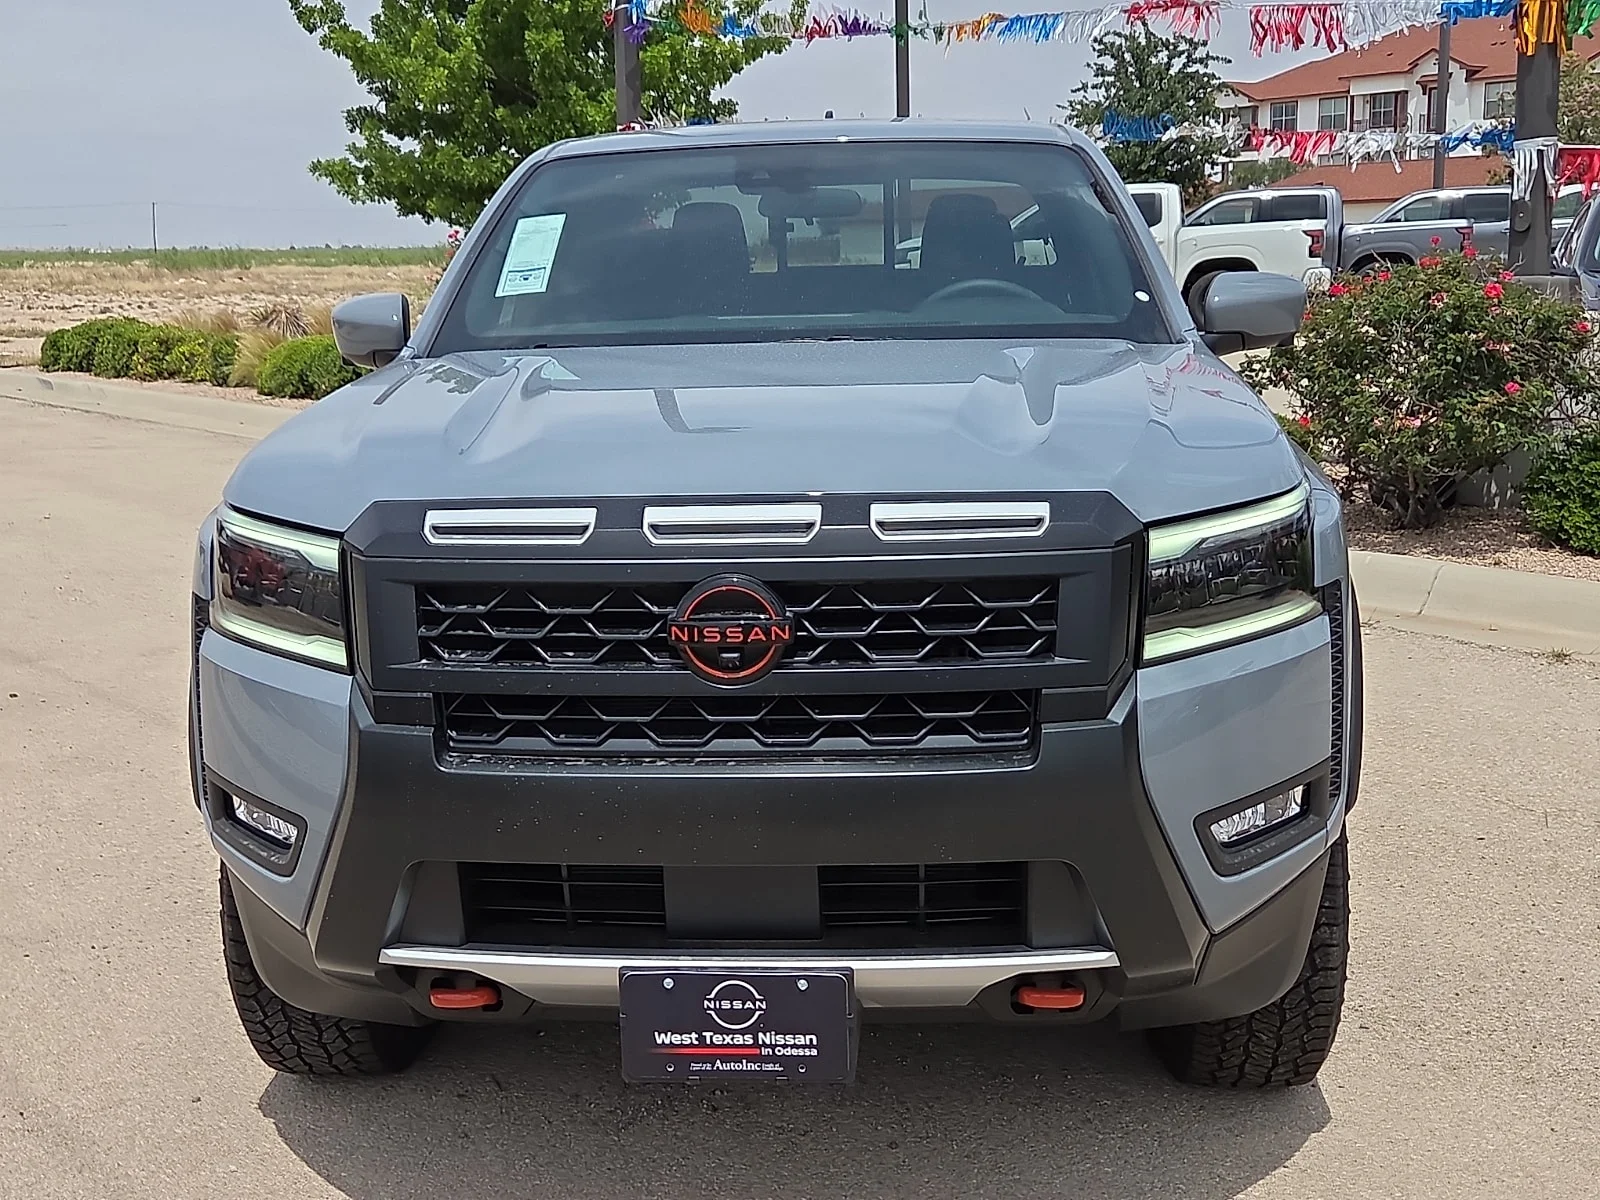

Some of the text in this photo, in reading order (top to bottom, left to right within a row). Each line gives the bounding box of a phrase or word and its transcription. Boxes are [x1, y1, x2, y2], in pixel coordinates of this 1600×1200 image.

[670, 625, 790, 643] NISSAN
[703, 1000, 767, 1010] NISSAN
[654, 1031, 818, 1046] West Texas Nissan
[775, 1047, 818, 1057] Odessa
[713, 1059, 762, 1071] AutoInc
